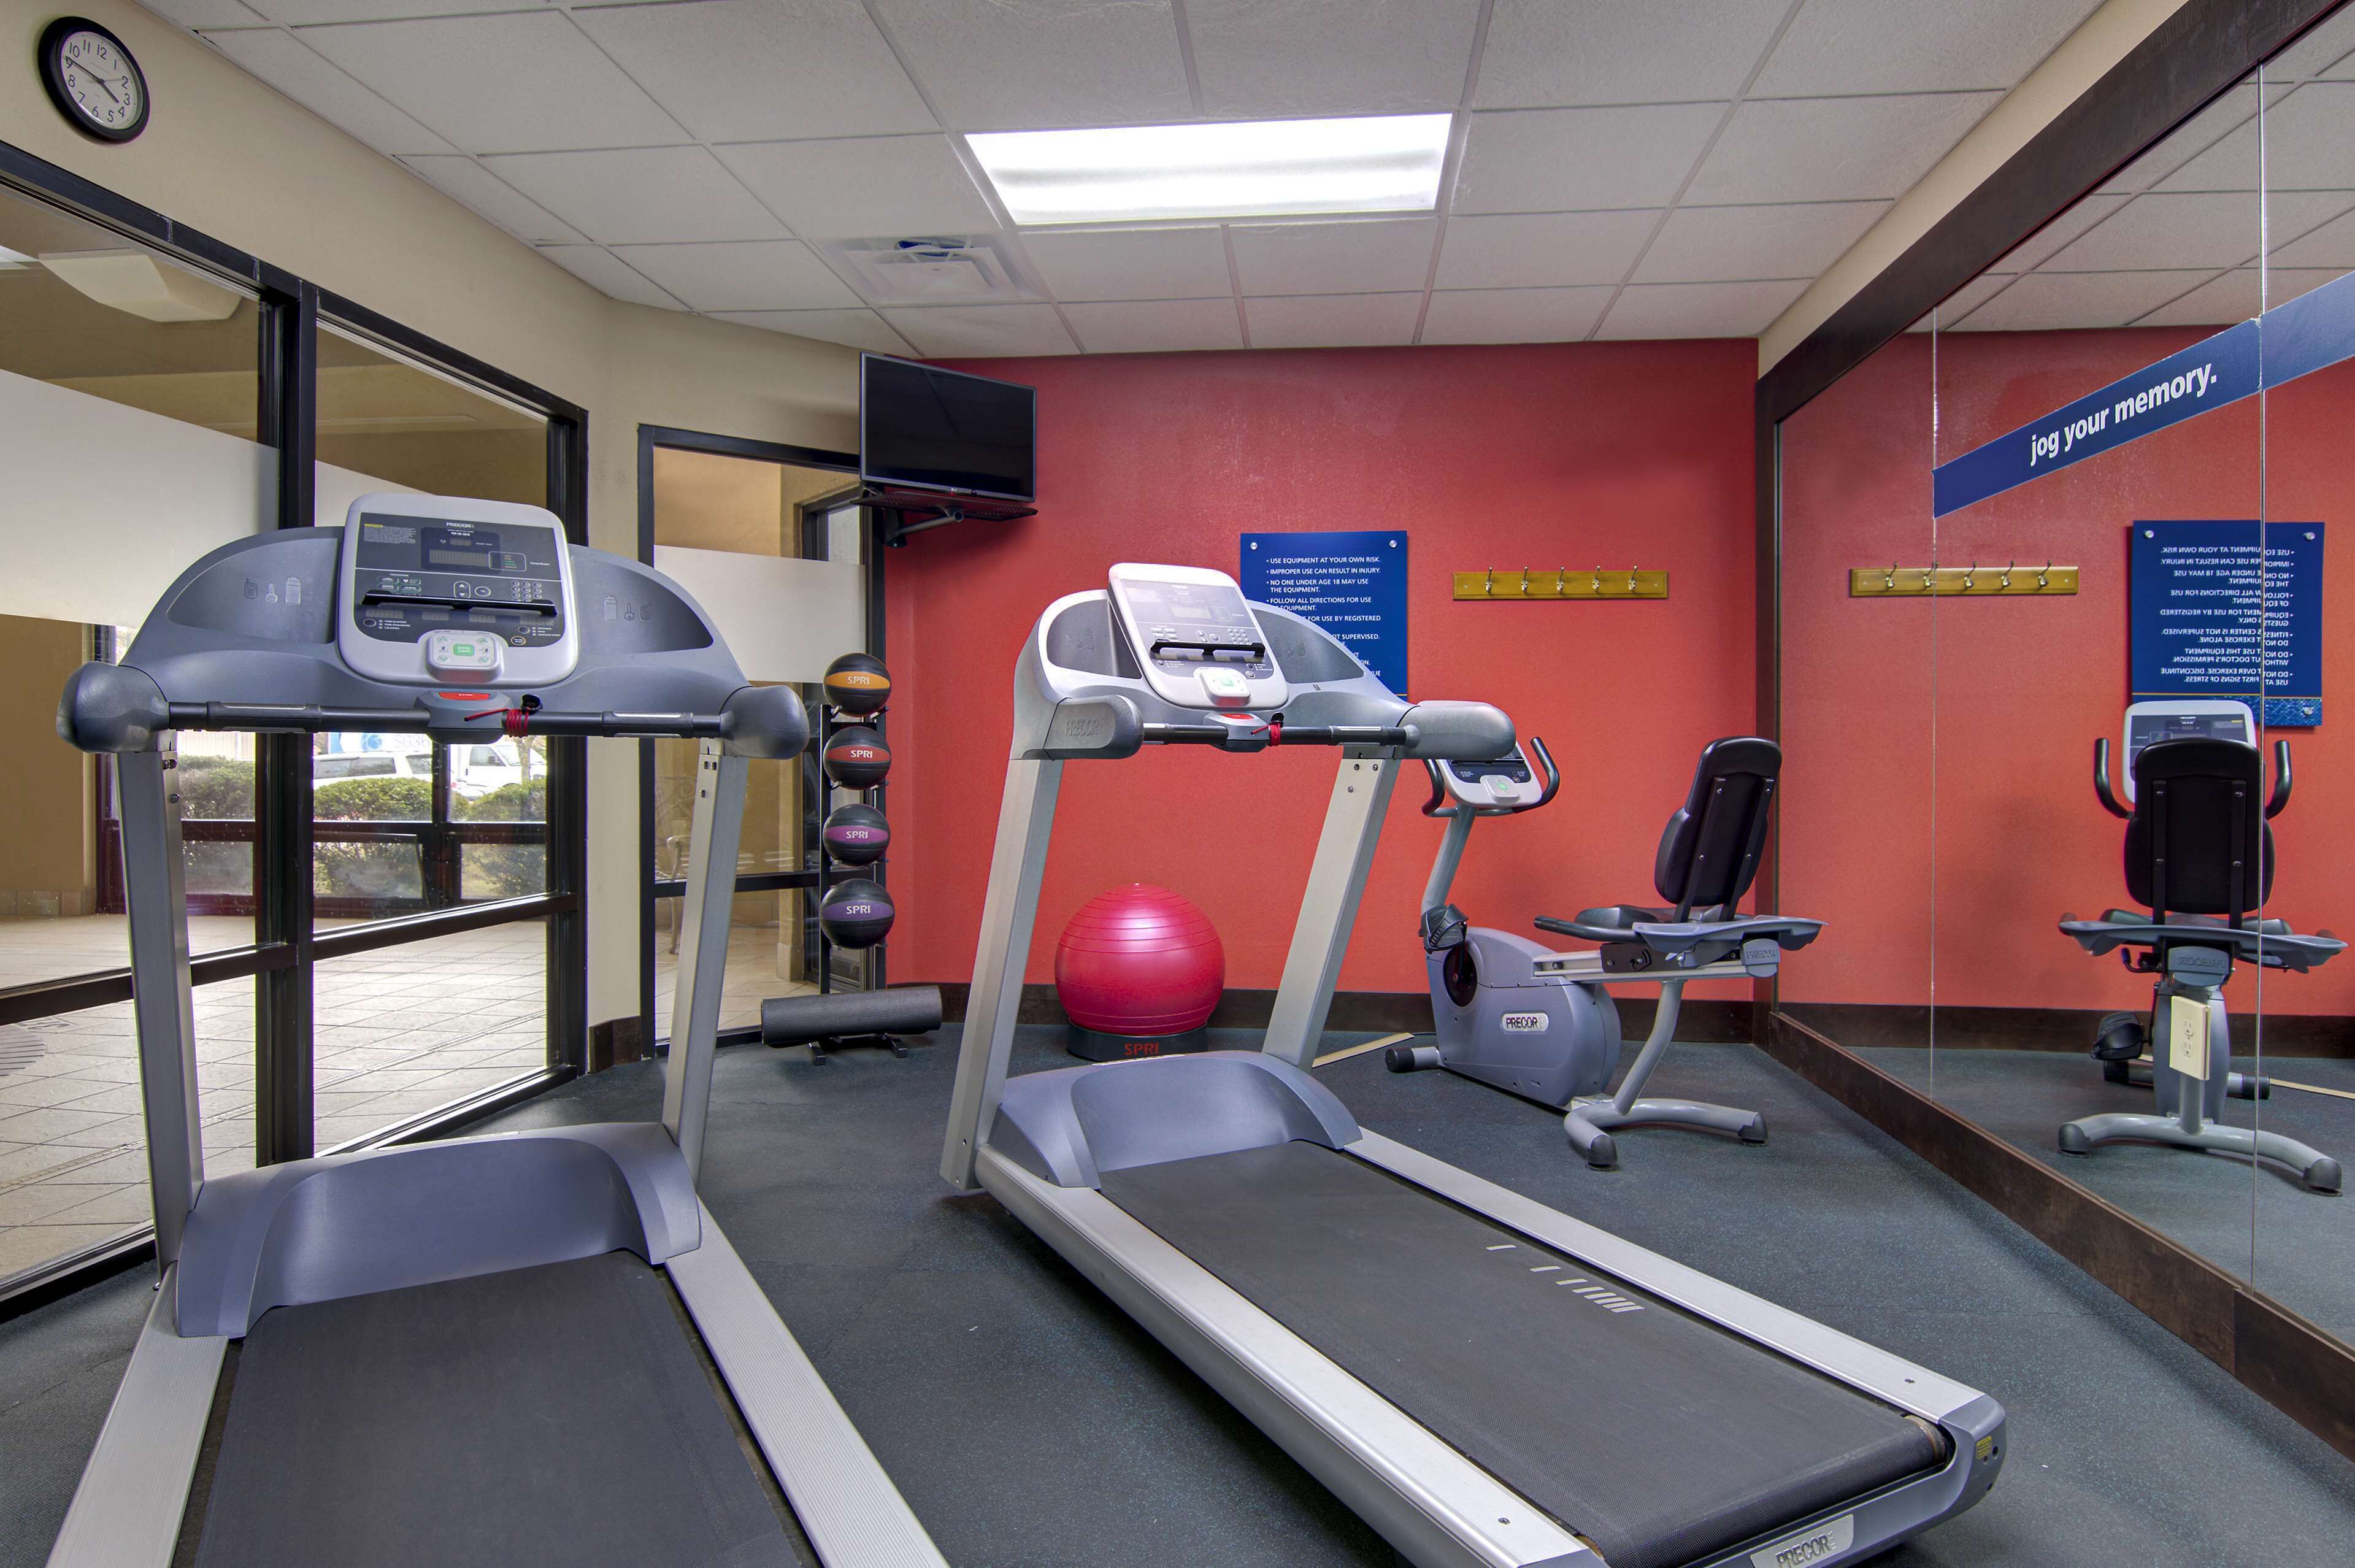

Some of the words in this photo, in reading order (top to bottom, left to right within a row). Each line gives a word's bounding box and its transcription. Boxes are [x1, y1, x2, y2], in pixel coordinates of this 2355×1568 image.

[69, 42, 80, 58] 10
[83, 39, 90, 53] 11
[97, 44, 107, 60] 12
[115, 60, 117, 70] 1
[68, 74, 75, 88] 8
[121, 75, 128, 90] 2
[79, 91, 86, 104] 7
[123, 93, 131, 106] 3
[92, 106, 99, 118] 6
[107, 110, 114, 123] 5
[118, 106, 125, 118] 4
[2030, 431, 2059, 466] jog
[2064, 408, 2109, 452] your
[2115, 363, 2217, 424] memory.
[846, 905, 870, 914] SPRI
[1506, 1017, 1539, 1029] PRECOR
[1124, 1043, 1159, 1056] SPRI
[1775, 1535, 1832, 1568] PRECOR
